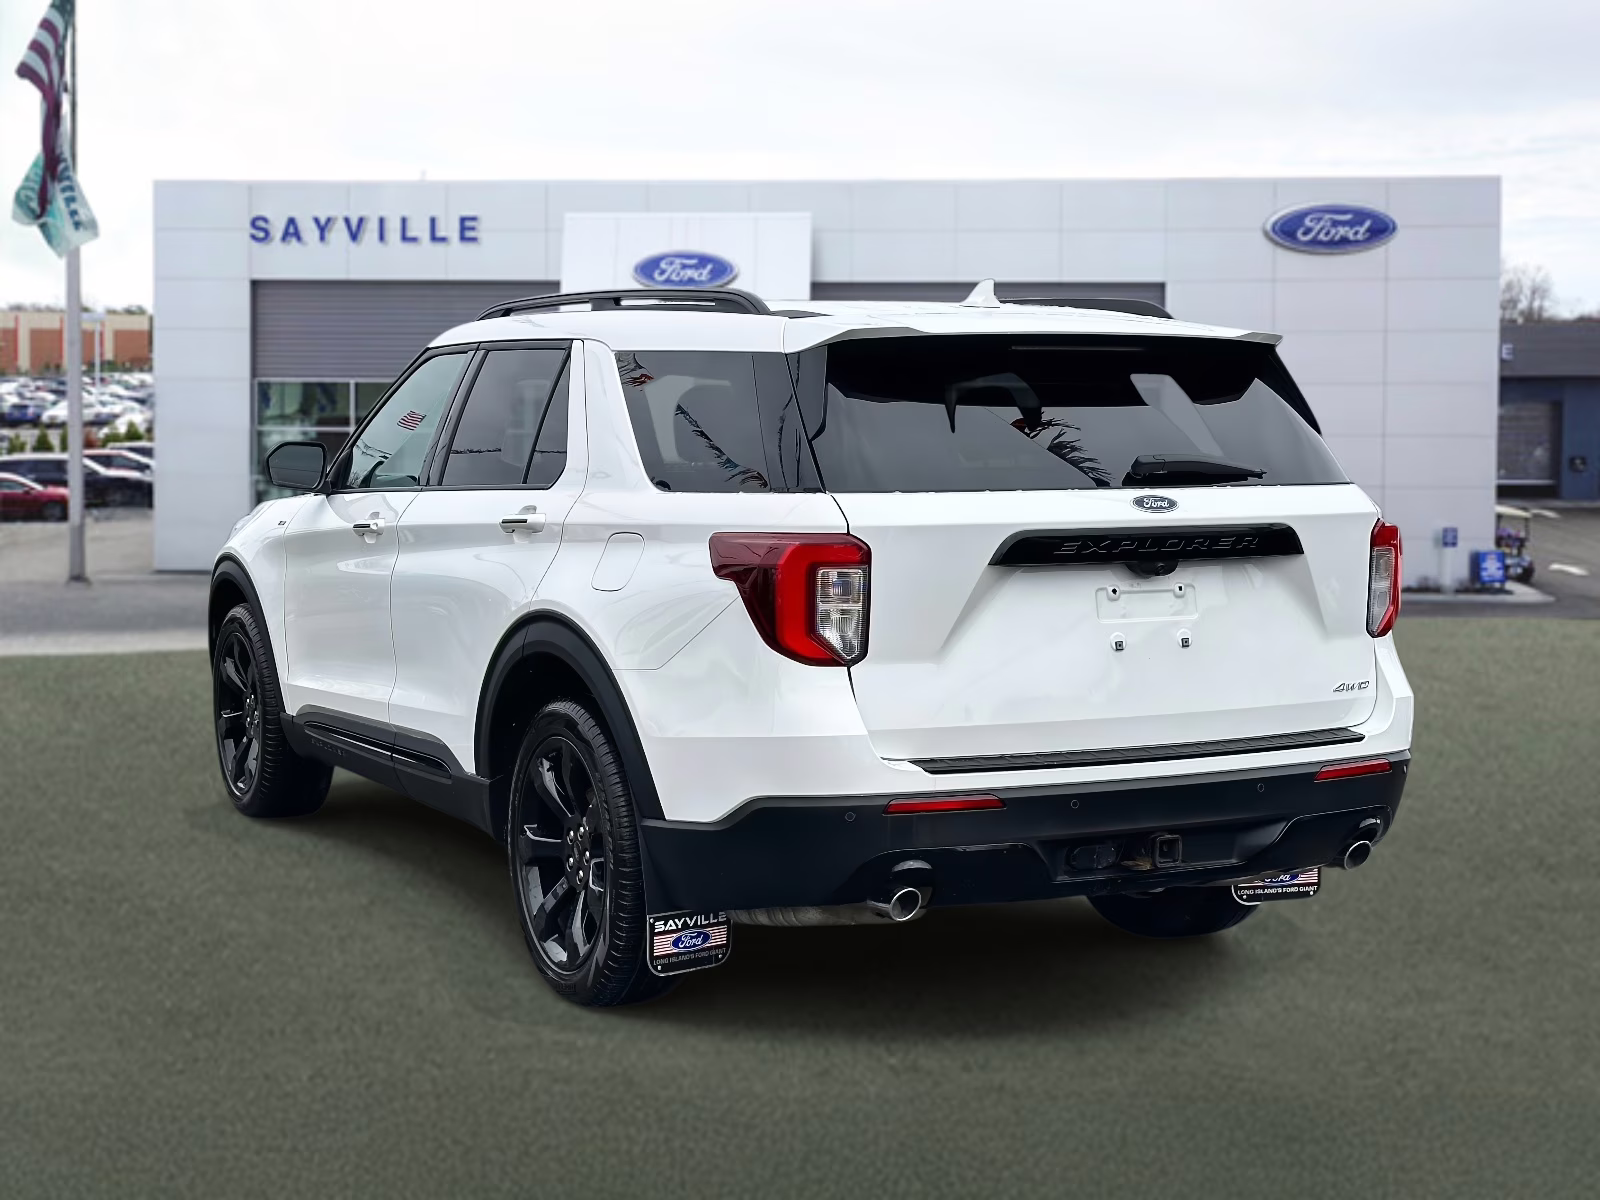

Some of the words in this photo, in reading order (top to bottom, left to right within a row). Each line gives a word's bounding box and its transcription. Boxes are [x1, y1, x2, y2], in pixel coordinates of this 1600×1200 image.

[249, 215, 479, 243] SAYVILLE
[1297, 212, 1371, 241] Ford
[654, 257, 713, 281] Ford
[1143, 497, 1169, 508] Ford
[1053, 536, 1259, 555] EXPLORER
[1332, 680, 1370, 692] 4WD
[654, 912, 727, 932] SAYVILLE
[678, 932, 704, 948] Ford
[654, 957, 669, 966] LONG
[695, 951, 710, 959] FORD
[710, 948, 726, 956] GIANT
